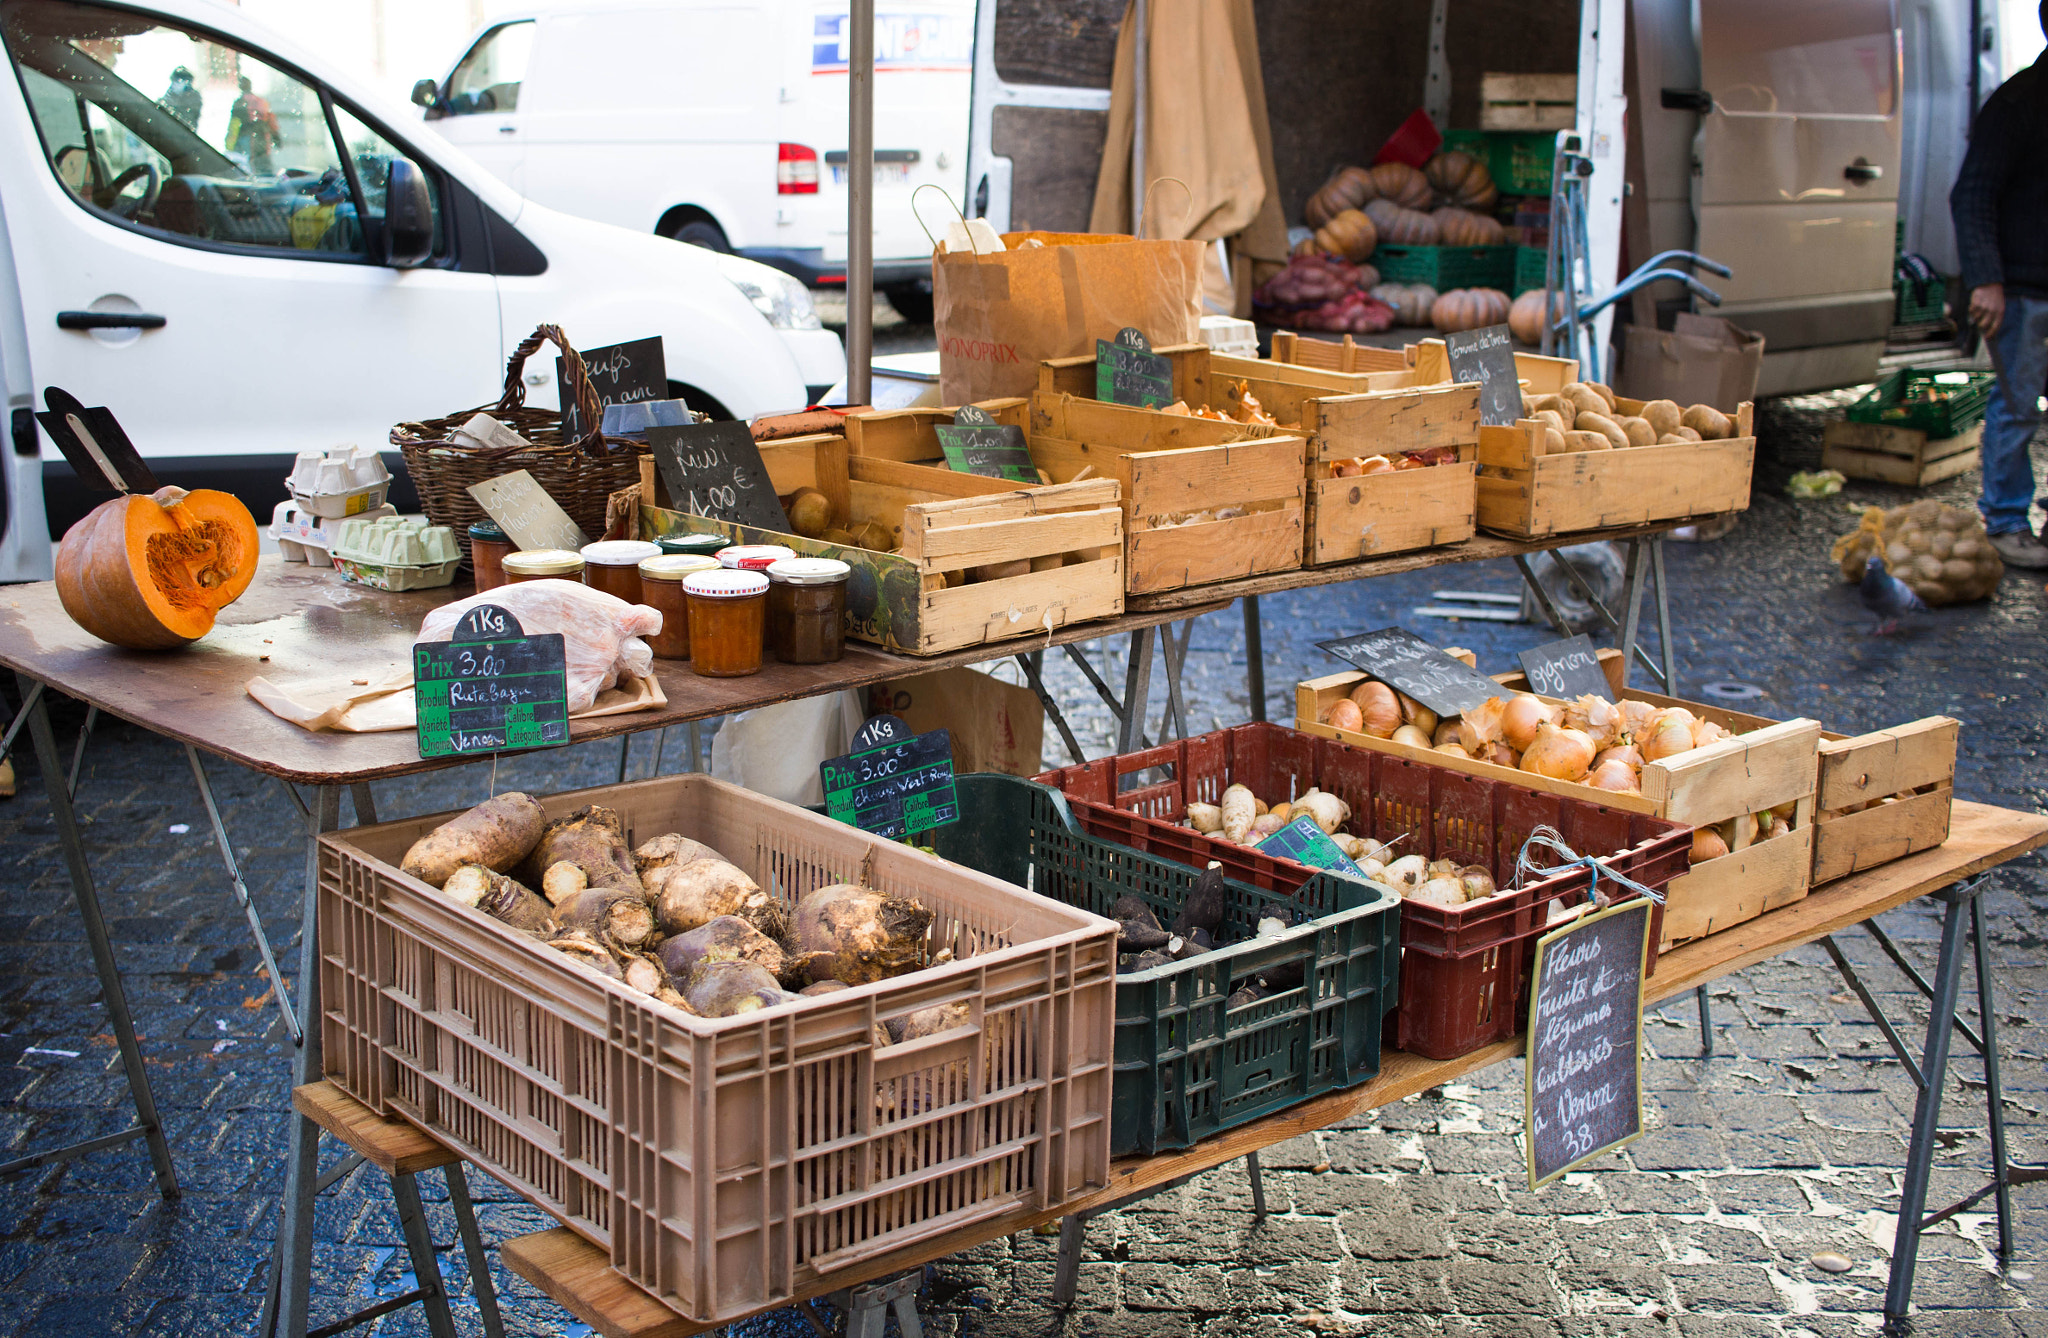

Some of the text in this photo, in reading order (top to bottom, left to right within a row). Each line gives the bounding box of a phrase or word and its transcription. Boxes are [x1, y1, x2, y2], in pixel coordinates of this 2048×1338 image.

[941, 334, 1020, 364] MONOPRIX
[1124, 331, 1144, 350] 1Kg
[1098, 344, 1116, 365] Prix
[960, 407, 984, 424] 1Kg
[937, 429, 964, 447] Prix
[733, 466, 755, 490] €
[469, 608, 505, 633] 1Kg
[417, 651, 454, 679] Prix
[418, 688, 448, 708] Produit
[420, 716, 448, 733] Variété
[507, 706, 534, 723] Calibre
[421, 736, 451, 753] Origine
[507, 724, 542, 745] Catégorie
[861, 720, 894, 746] 1Kg
[824, 766, 857, 791] Prix
[895, 745, 909, 757] €
[829, 796, 854, 816] Produit
[904, 798, 929, 813] Calibre
[906, 812, 937, 831] Catégorie
[1562, 1122, 1594, 1160] 38
